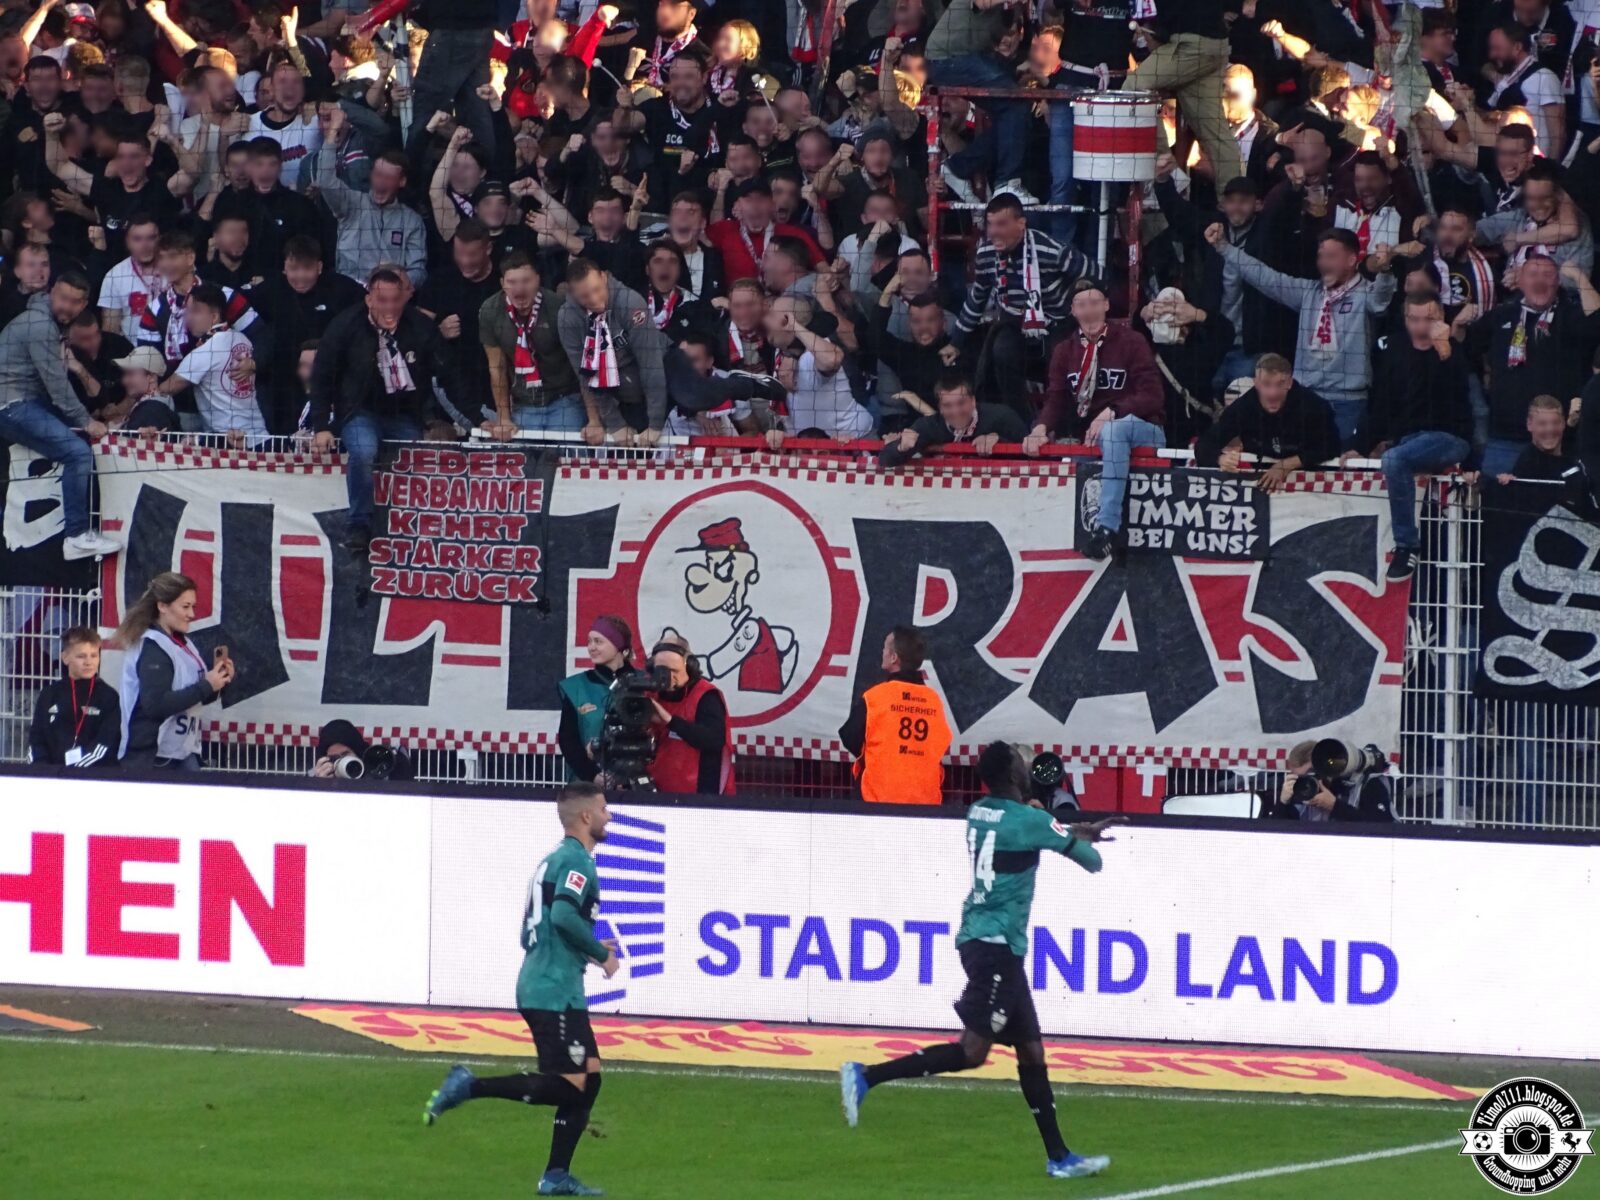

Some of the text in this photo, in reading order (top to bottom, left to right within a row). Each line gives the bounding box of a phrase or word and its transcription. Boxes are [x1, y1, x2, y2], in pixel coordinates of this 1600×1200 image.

[392, 448, 526, 478] JEDER
[372, 471, 544, 513] VERBANNTE
[1129, 473, 1260, 502] DU BIST
[388, 509, 528, 541] KEHRT
[1129, 499, 1257, 532] IMMER
[1127, 528, 1260, 555] BEI UNS!
[370, 566, 538, 602] ZURÜCK
[898, 716, 929, 742] 89
[697, 910, 1400, 1006] STADT ND LAND
